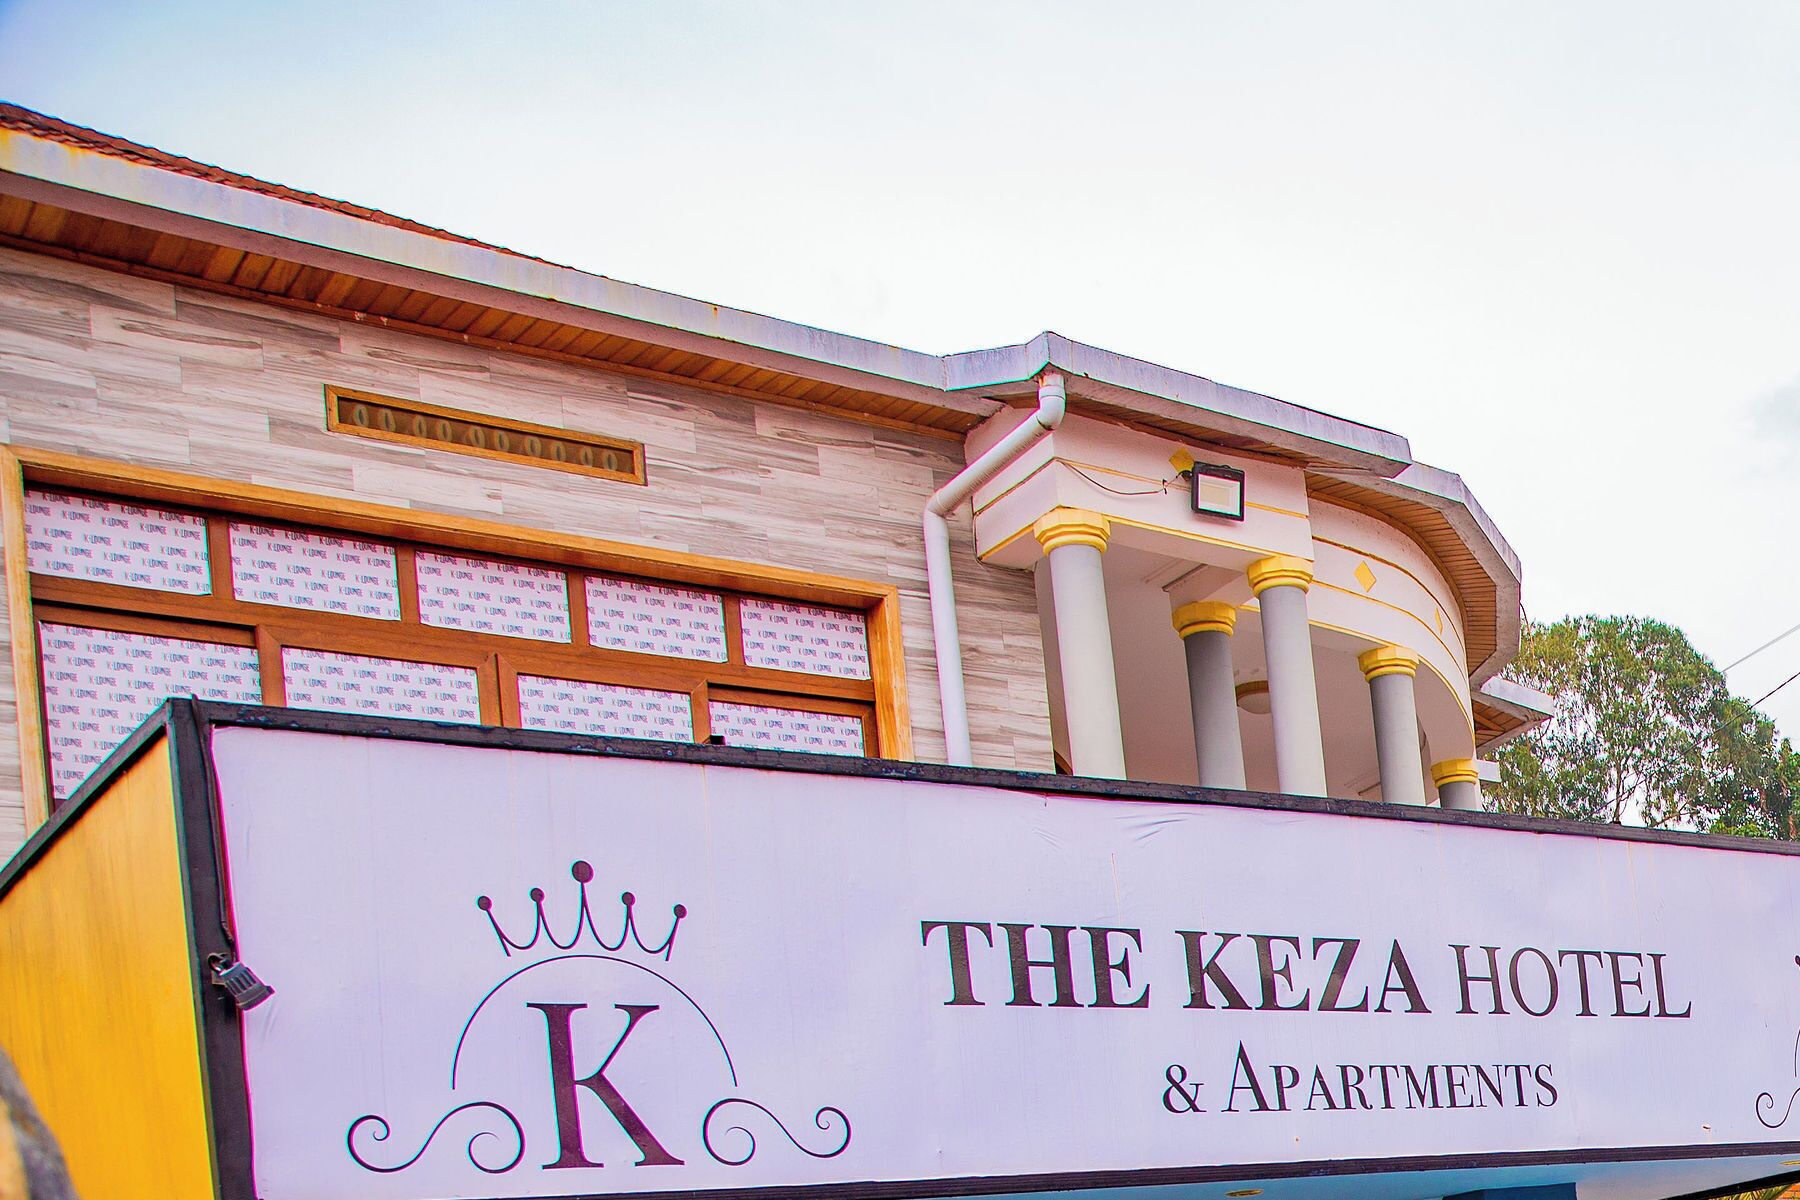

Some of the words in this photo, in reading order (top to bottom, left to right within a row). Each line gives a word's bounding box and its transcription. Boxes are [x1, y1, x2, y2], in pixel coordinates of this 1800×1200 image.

[921, 921, 1150, 1008] THE
[1175, 931, 1432, 1013] KEZA
[1448, 945, 1691, 1018] HOTEL
[527, 1003, 684, 1169] K
[1163, 1065, 1206, 1113] &
